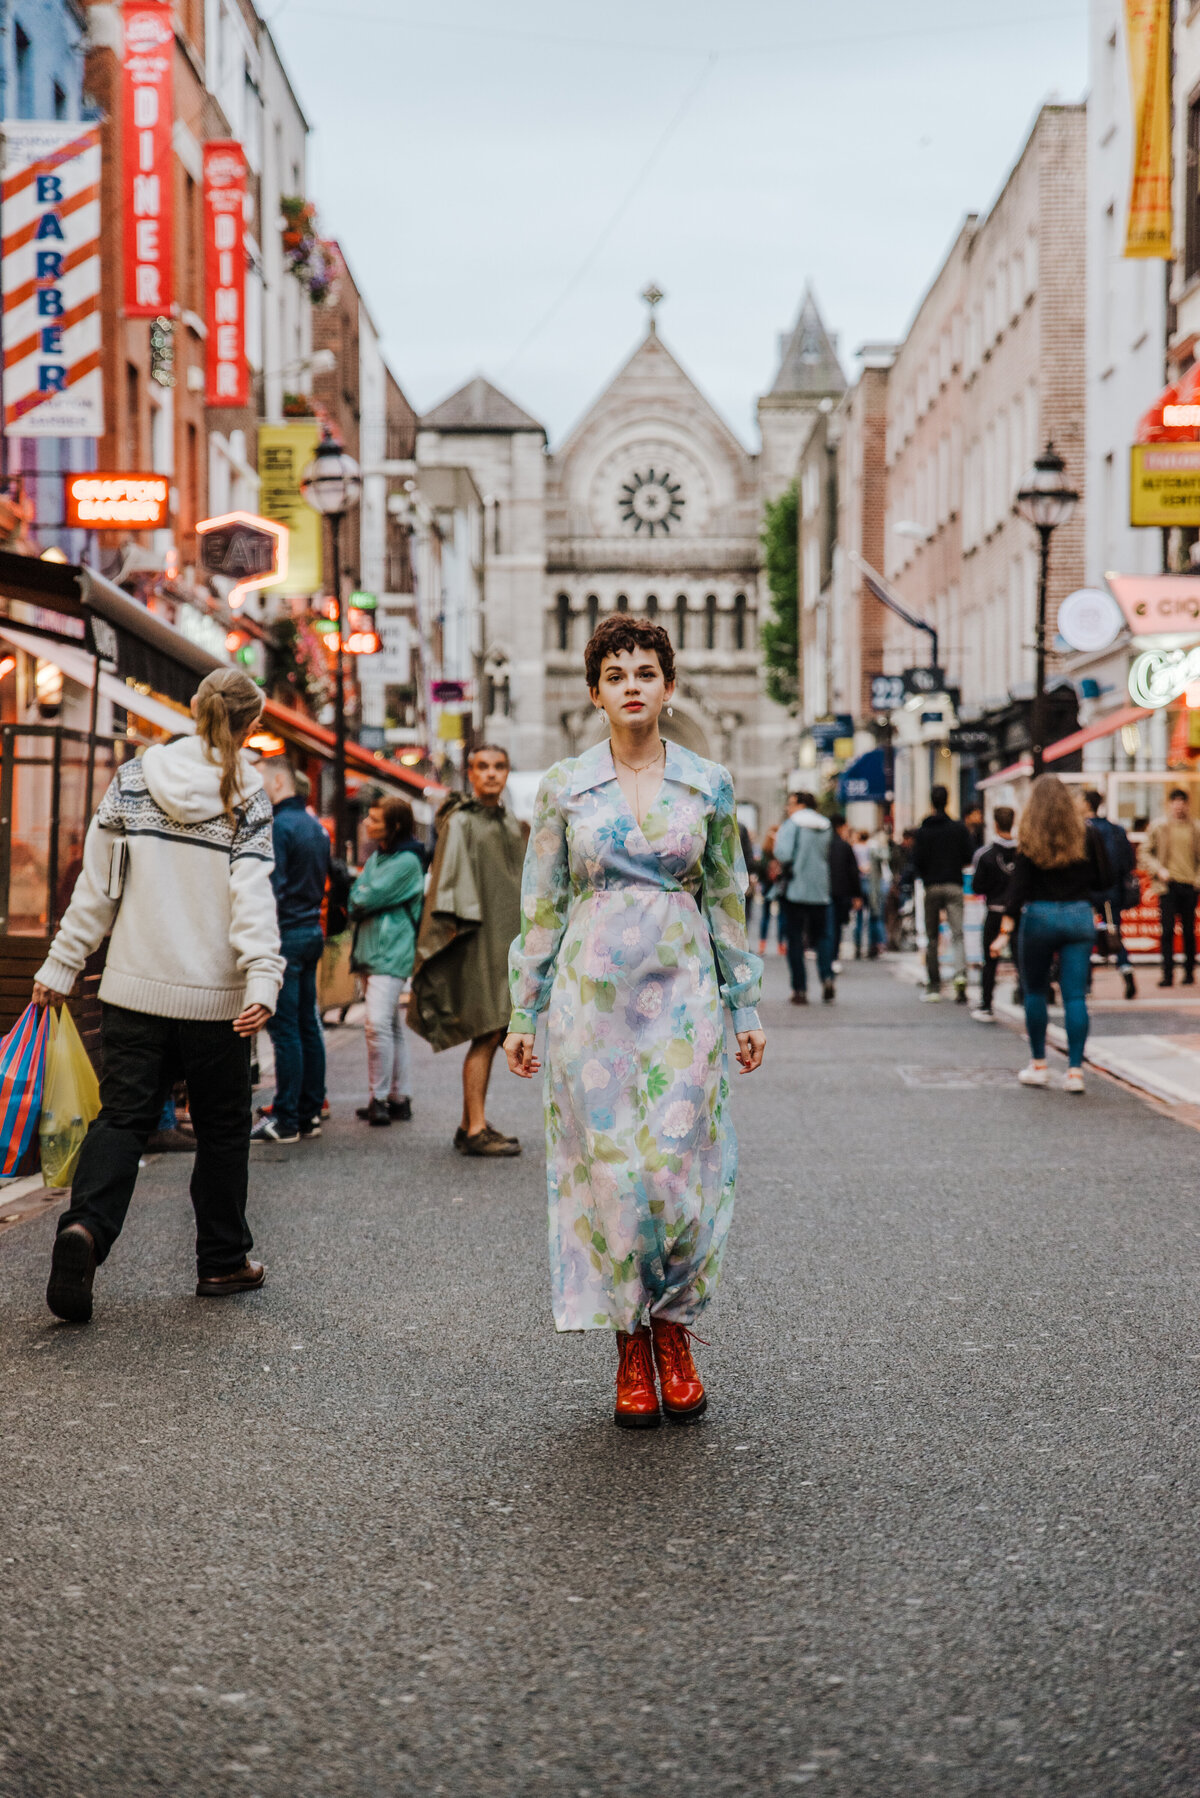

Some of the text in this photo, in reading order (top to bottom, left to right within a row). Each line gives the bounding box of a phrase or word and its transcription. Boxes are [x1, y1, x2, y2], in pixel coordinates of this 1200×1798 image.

[36, 174, 67, 393] BARBER
[133, 86, 161, 307] DINER
[213, 214, 239, 397] DINER
[206, 531, 272, 569] EAT
